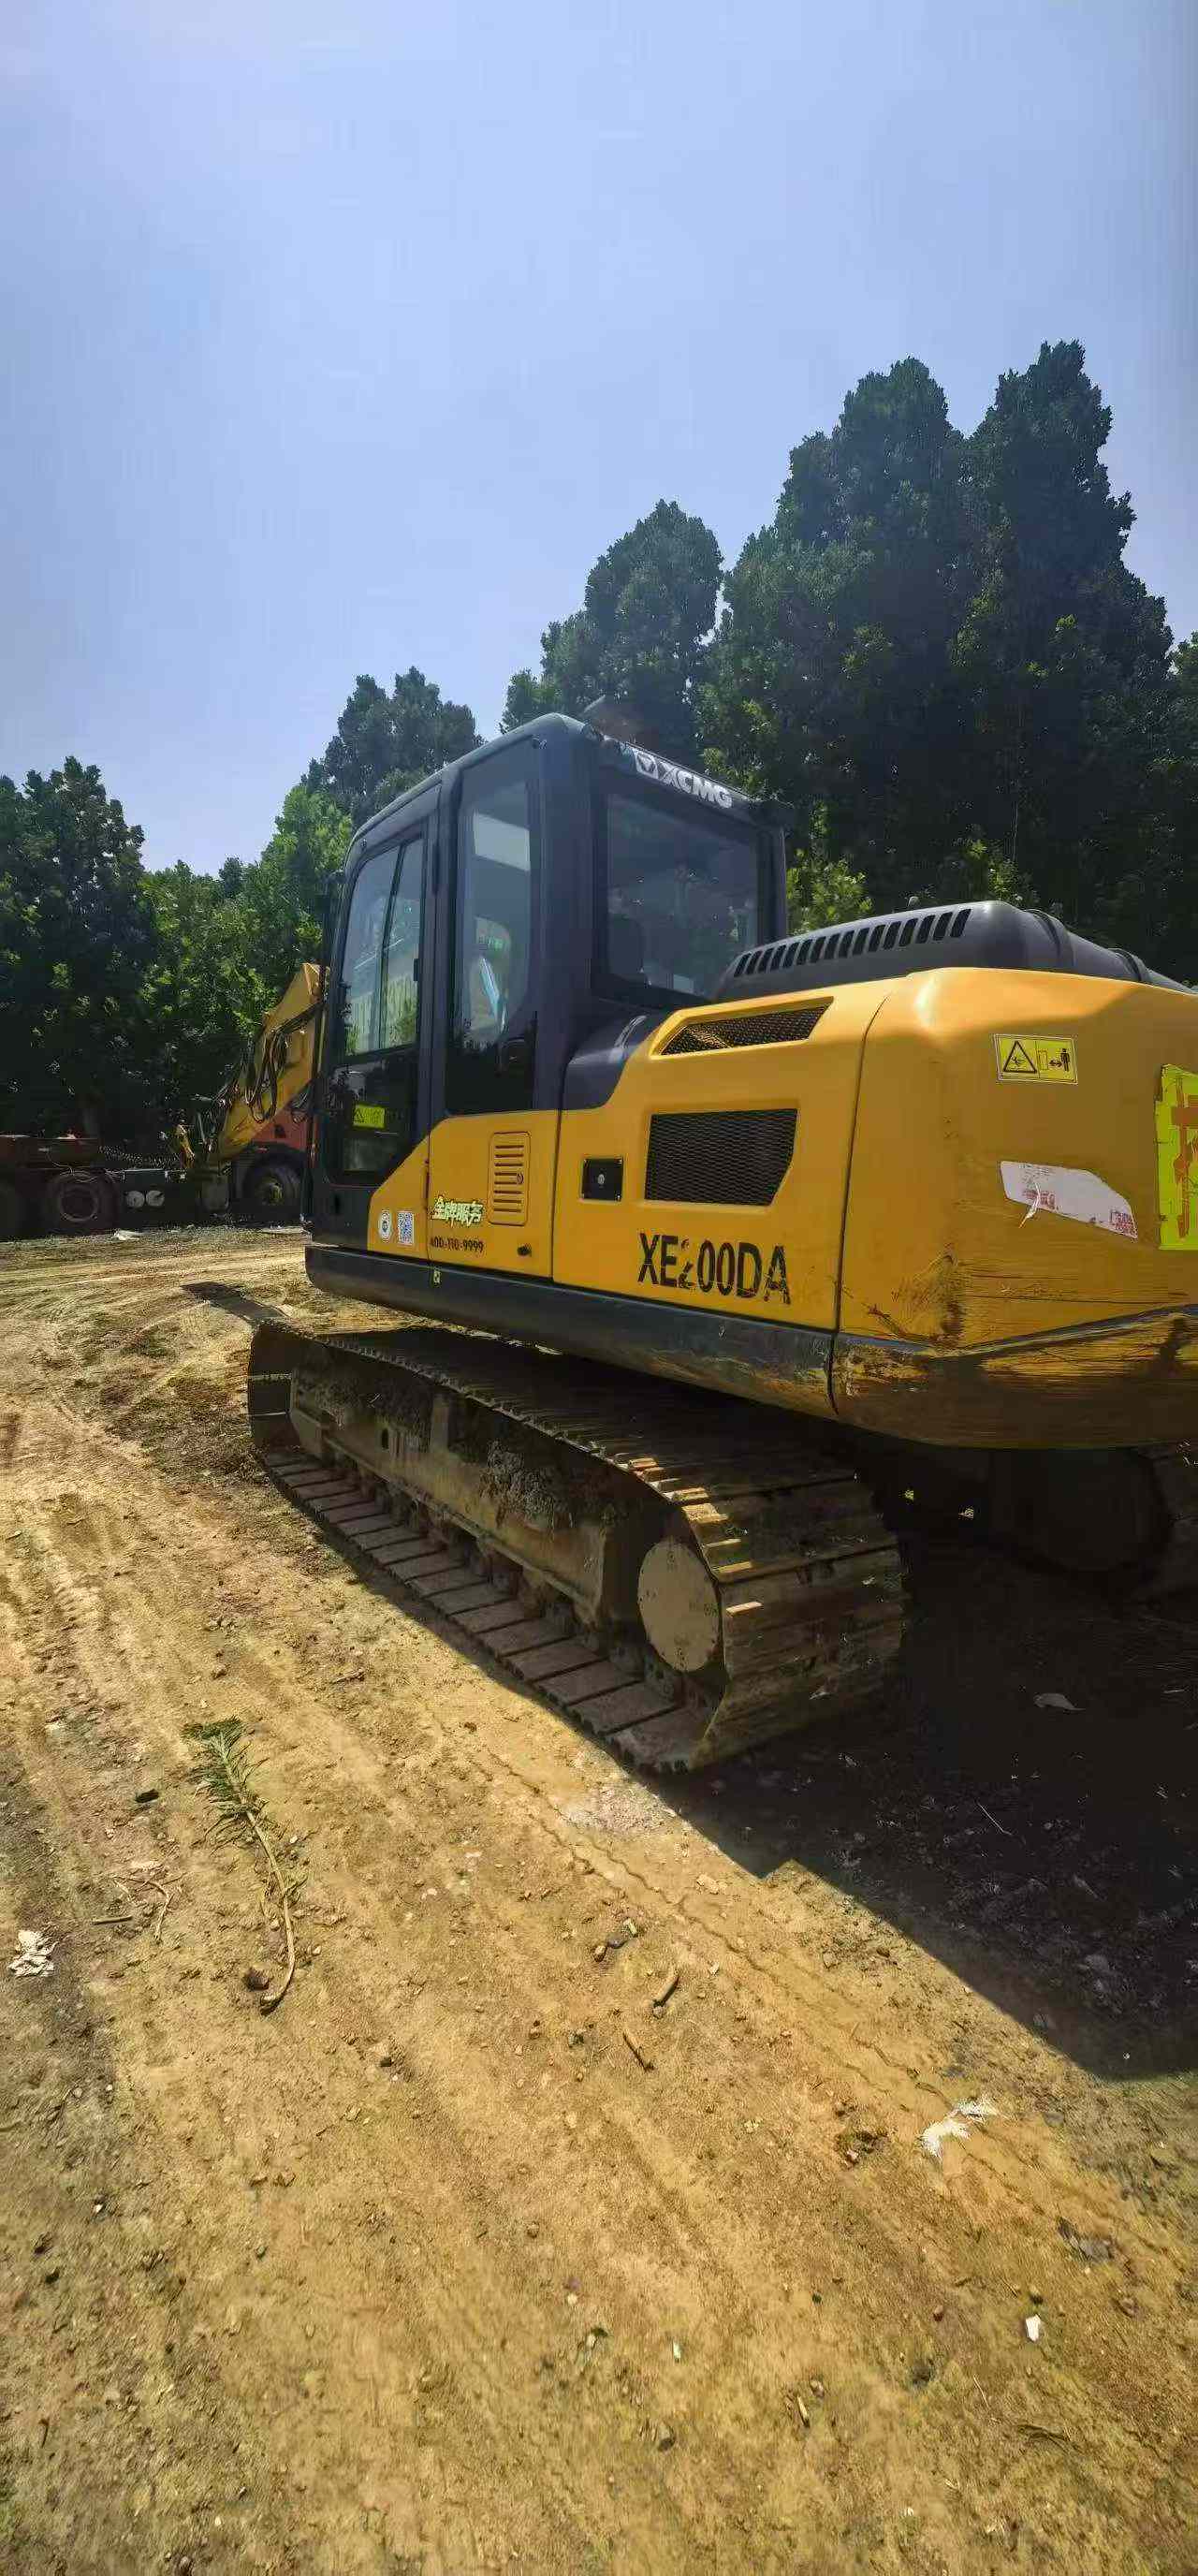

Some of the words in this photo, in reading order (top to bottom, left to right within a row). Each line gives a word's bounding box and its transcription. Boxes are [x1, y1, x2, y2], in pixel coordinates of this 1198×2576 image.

[657, 760, 733, 809] XCMG
[431, 1194, 484, 1227] 金牌服务
